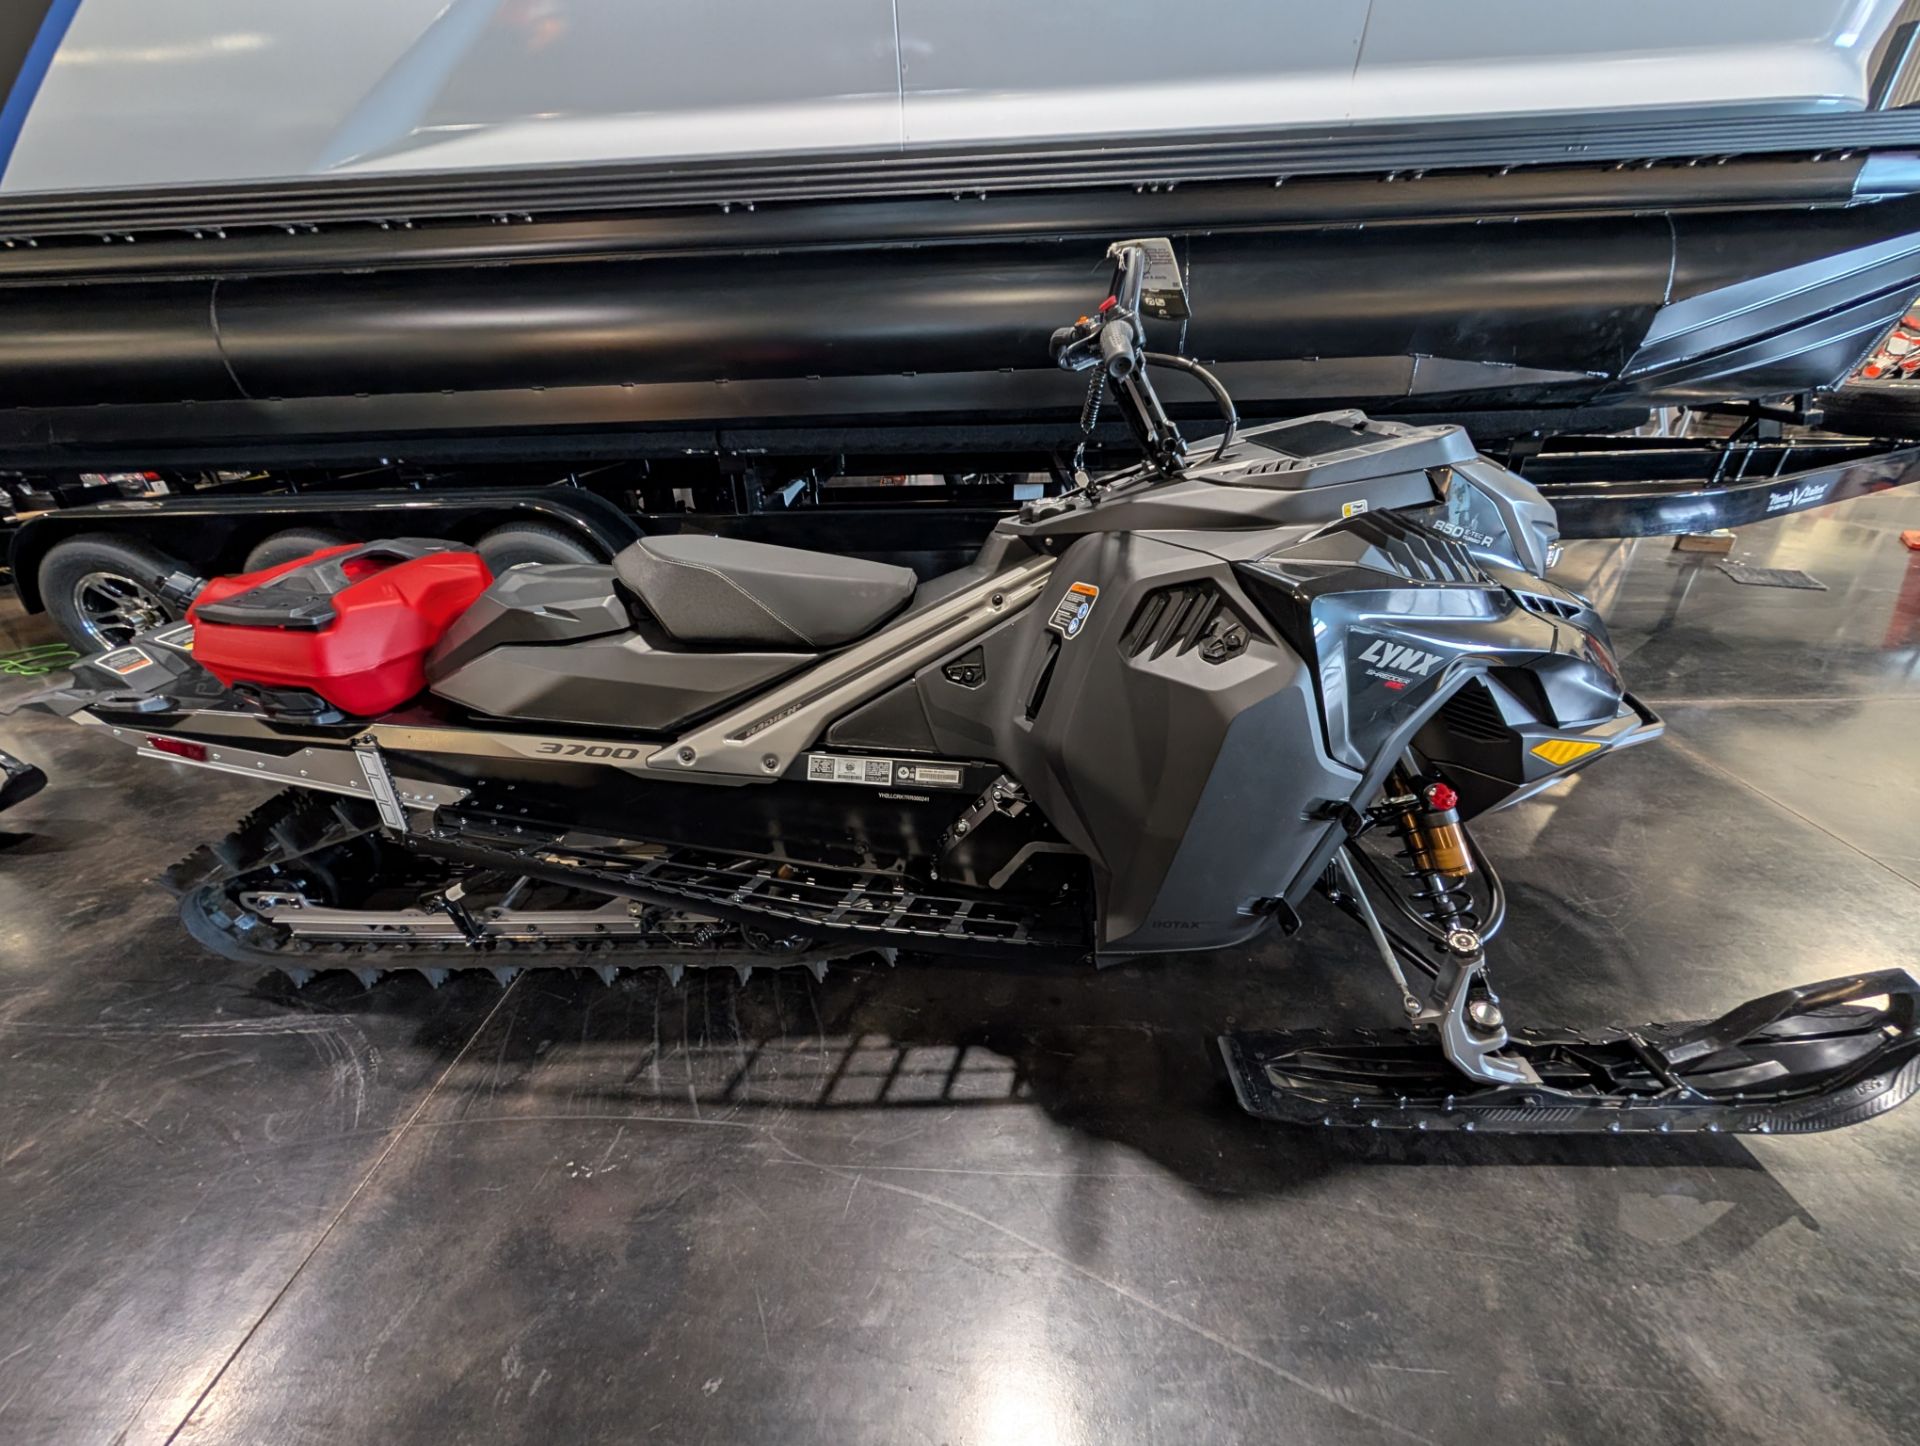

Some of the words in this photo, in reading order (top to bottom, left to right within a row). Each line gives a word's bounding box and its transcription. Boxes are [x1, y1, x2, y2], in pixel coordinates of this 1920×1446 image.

[1433, 519, 1464, 538] 850
[1481, 535, 1494, 547] R
[1358, 639, 1445, 676] LYNX
[536, 742, 640, 760] 3700
[1152, 920, 1200, 929] ROTAX
